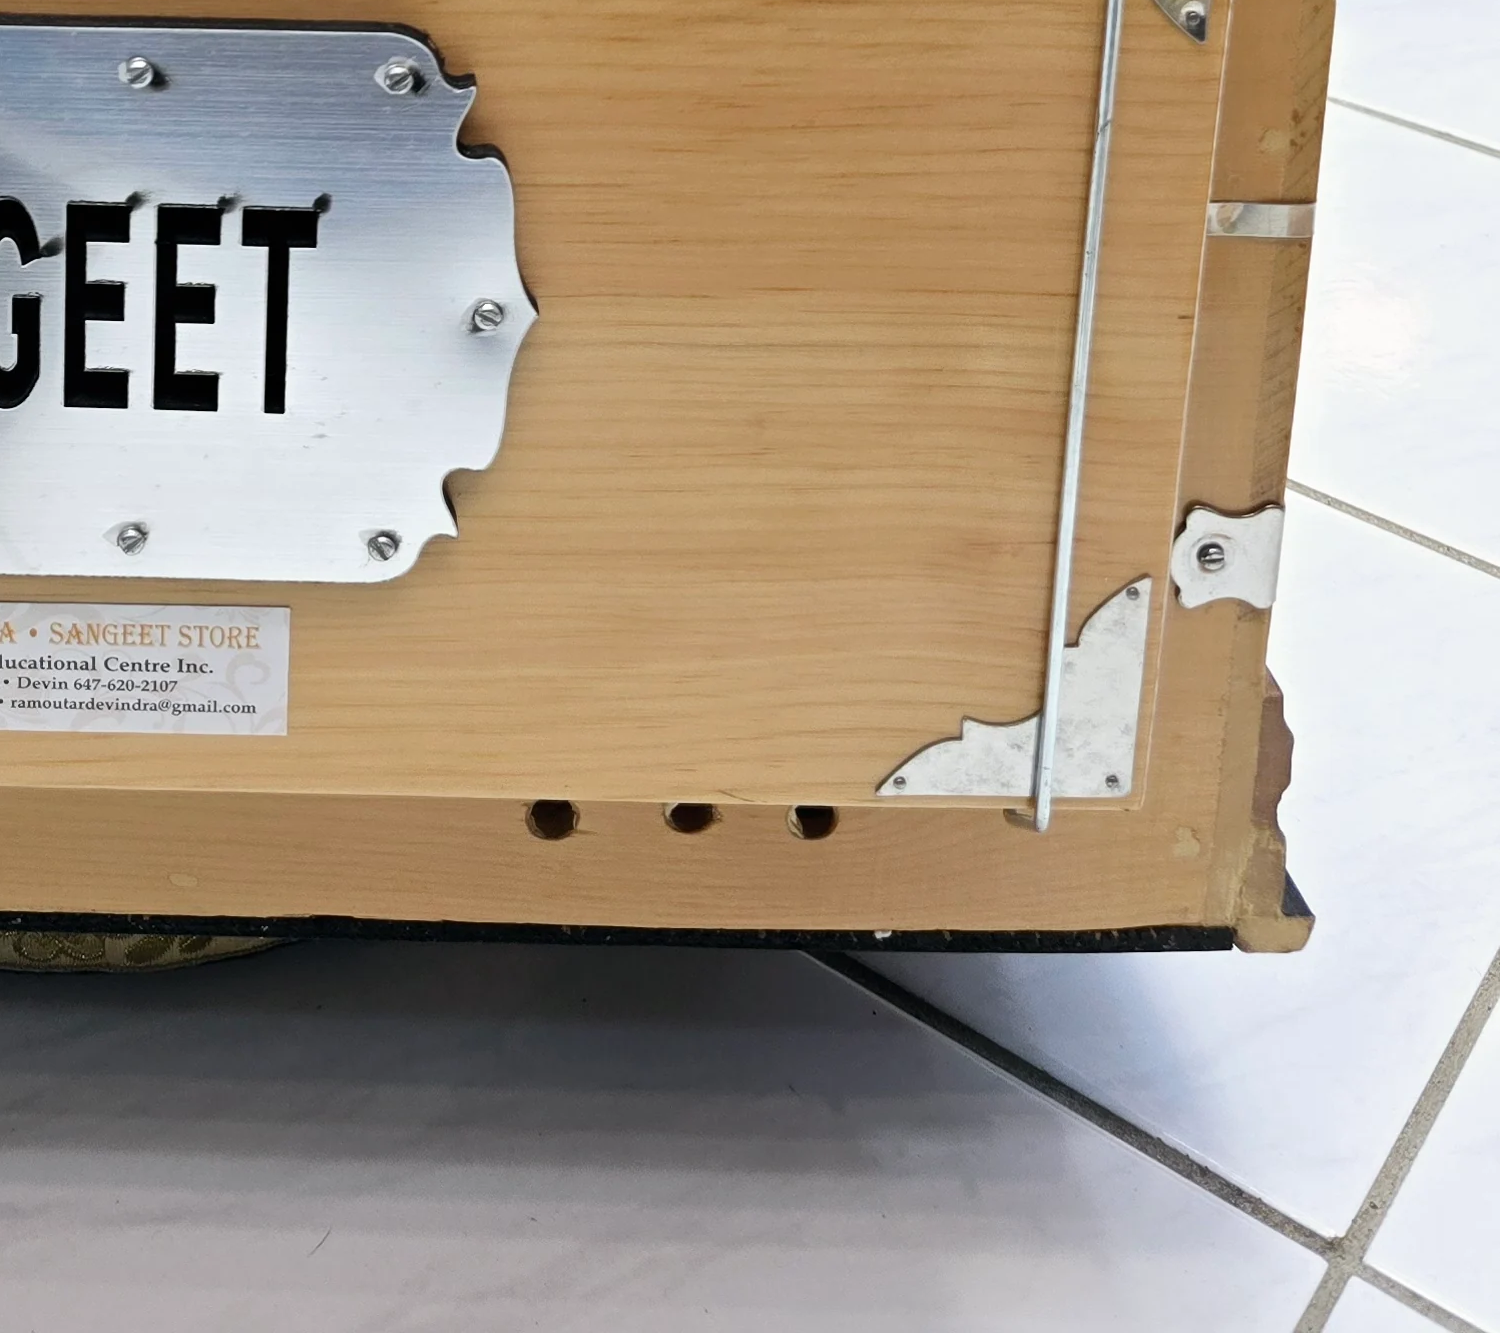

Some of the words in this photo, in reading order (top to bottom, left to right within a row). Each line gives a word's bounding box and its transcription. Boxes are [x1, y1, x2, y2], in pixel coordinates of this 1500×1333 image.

[48, 621, 172, 647] SANGEET
[177, 624, 263, 650] STORE
[103, 656, 171, 674] Centre
[176, 657, 215, 675] Inc.
[16, 675, 69, 690] Devin
[73, 677, 179, 693] 647-620-2107
[9, 696, 257, 716] ramoutardevindra@gmail.com
